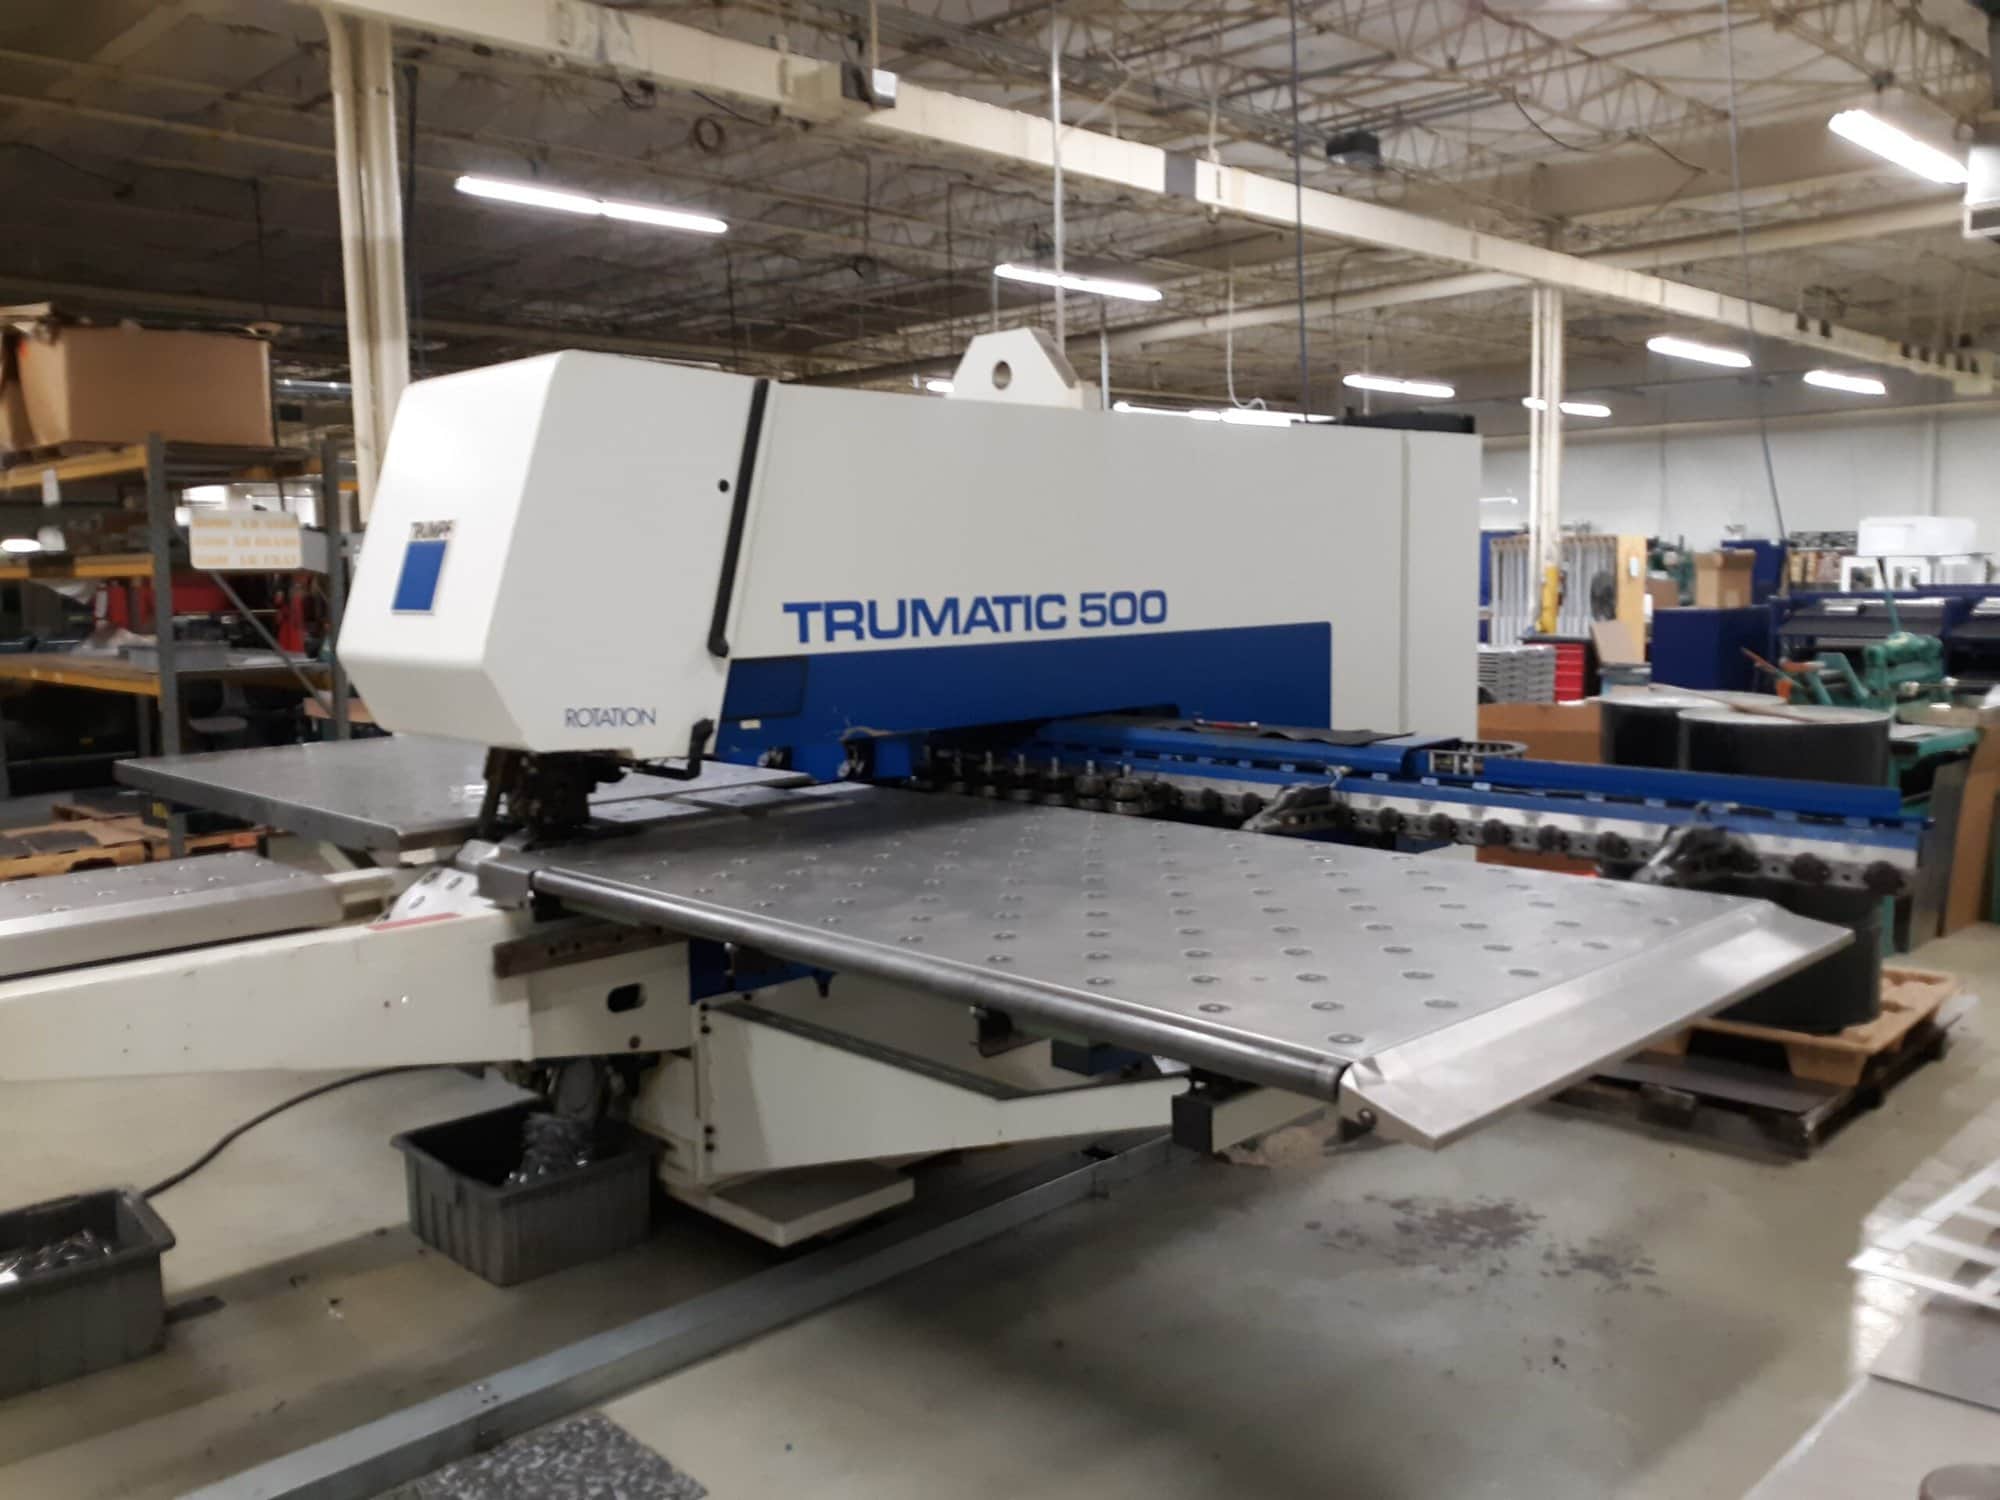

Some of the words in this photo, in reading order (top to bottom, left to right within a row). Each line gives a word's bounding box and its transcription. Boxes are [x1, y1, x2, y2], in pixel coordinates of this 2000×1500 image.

[783, 593, 1067, 643] TRUMATIC
[1079, 589, 1168, 628] 500
[565, 707, 656, 727] ROTATION
